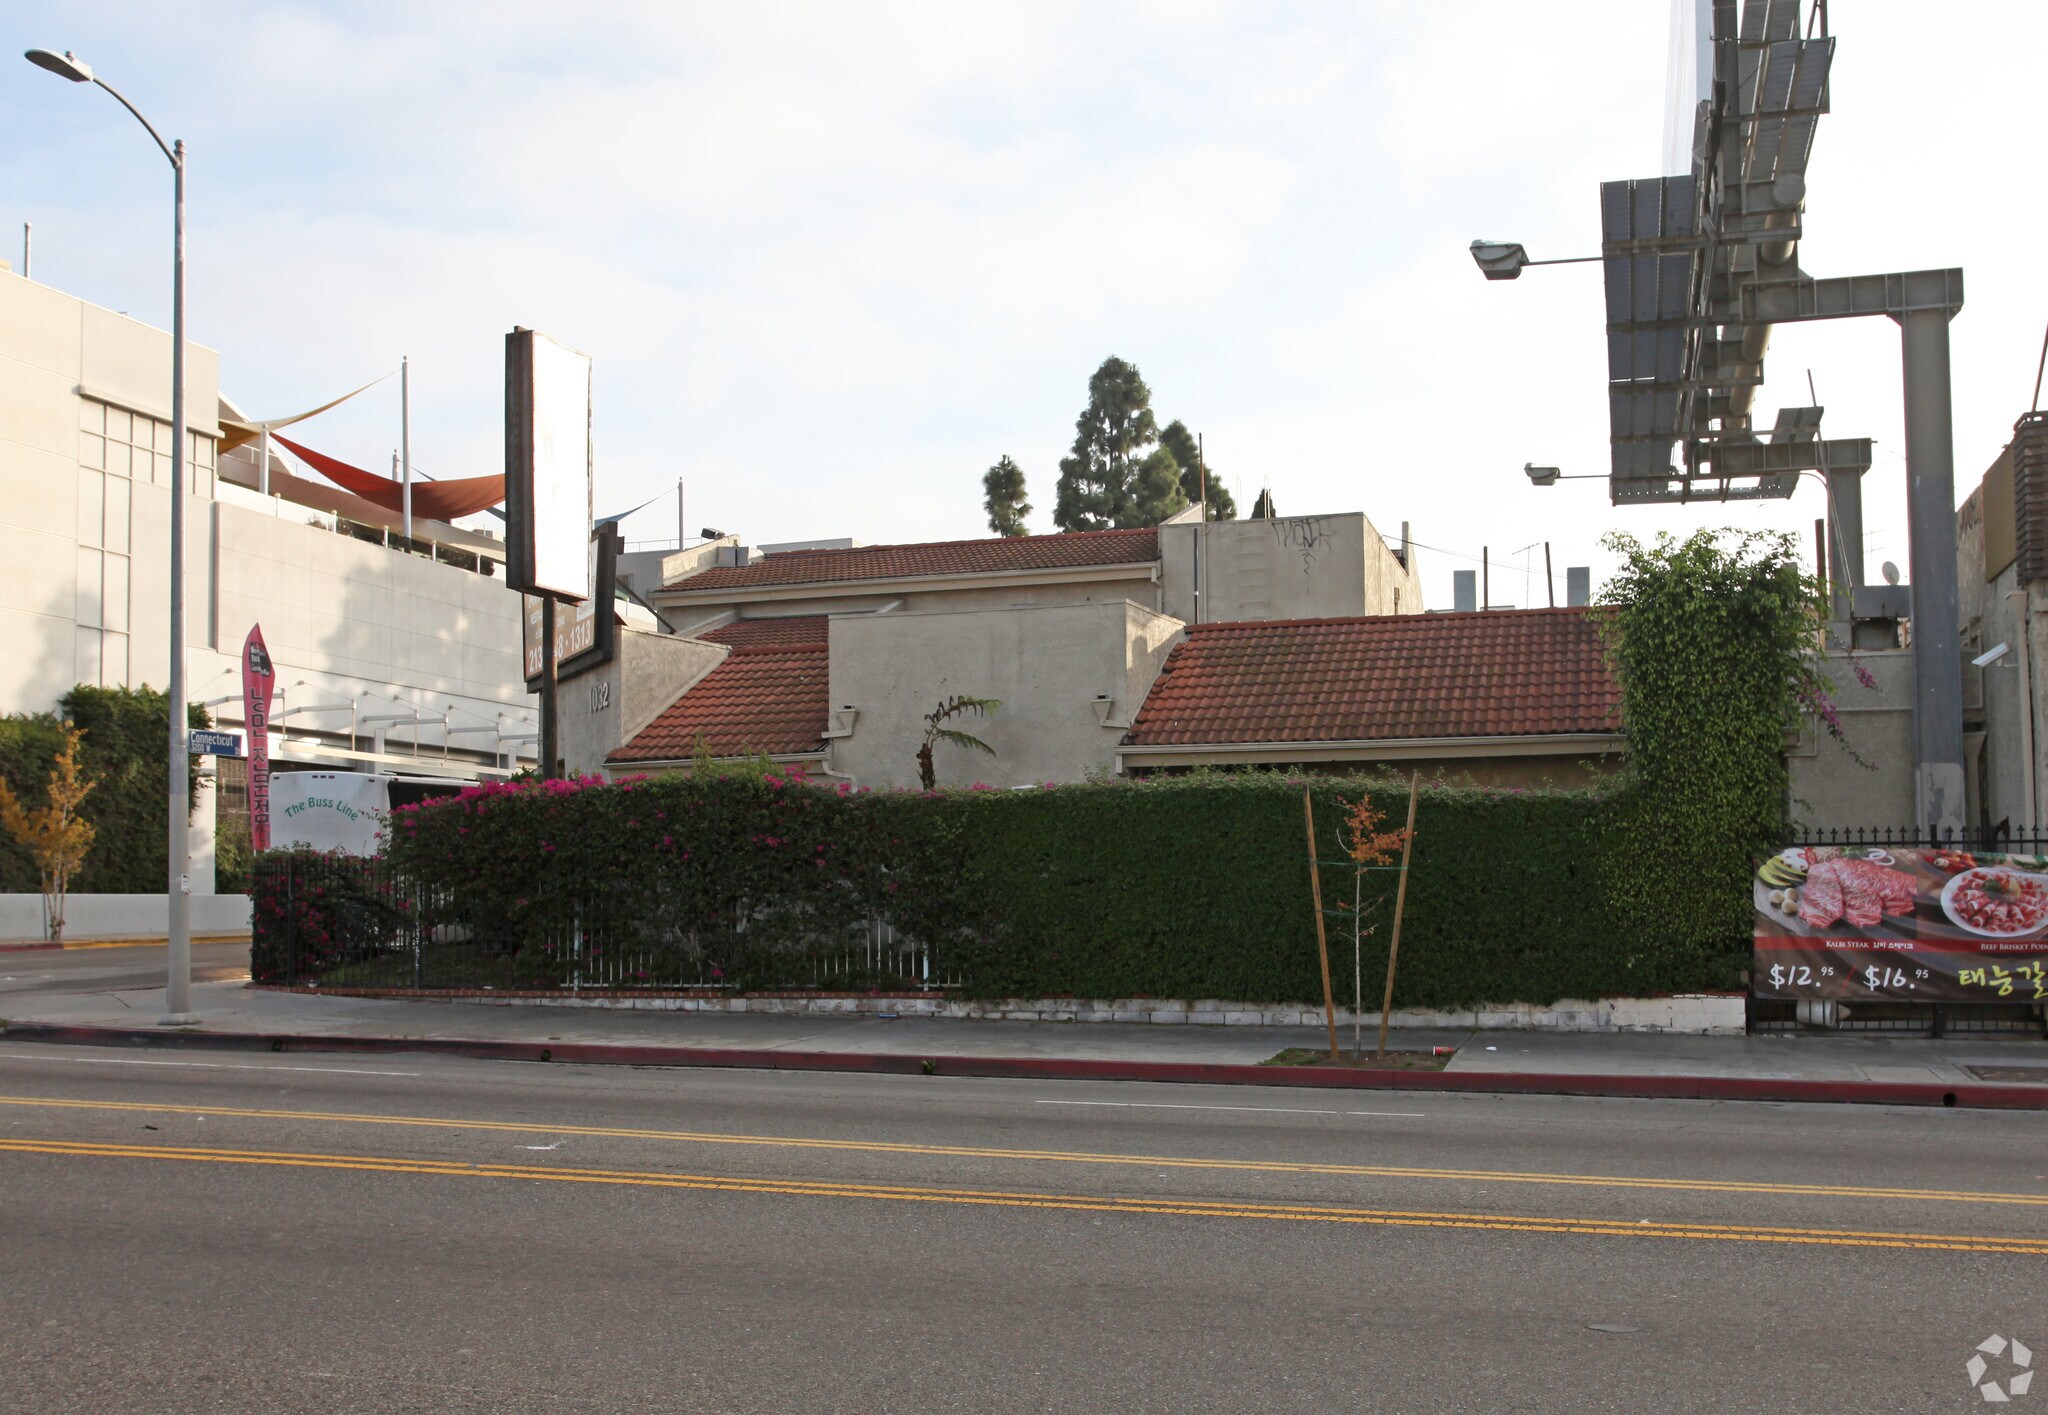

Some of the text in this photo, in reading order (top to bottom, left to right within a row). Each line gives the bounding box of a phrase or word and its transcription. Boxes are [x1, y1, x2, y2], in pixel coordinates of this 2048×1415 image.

[590, 681, 609, 712] 1032
[190, 731, 234, 746] Connecticut
[190, 742, 205, 752] 3200
[284, 796, 358, 821] The Buss Line
